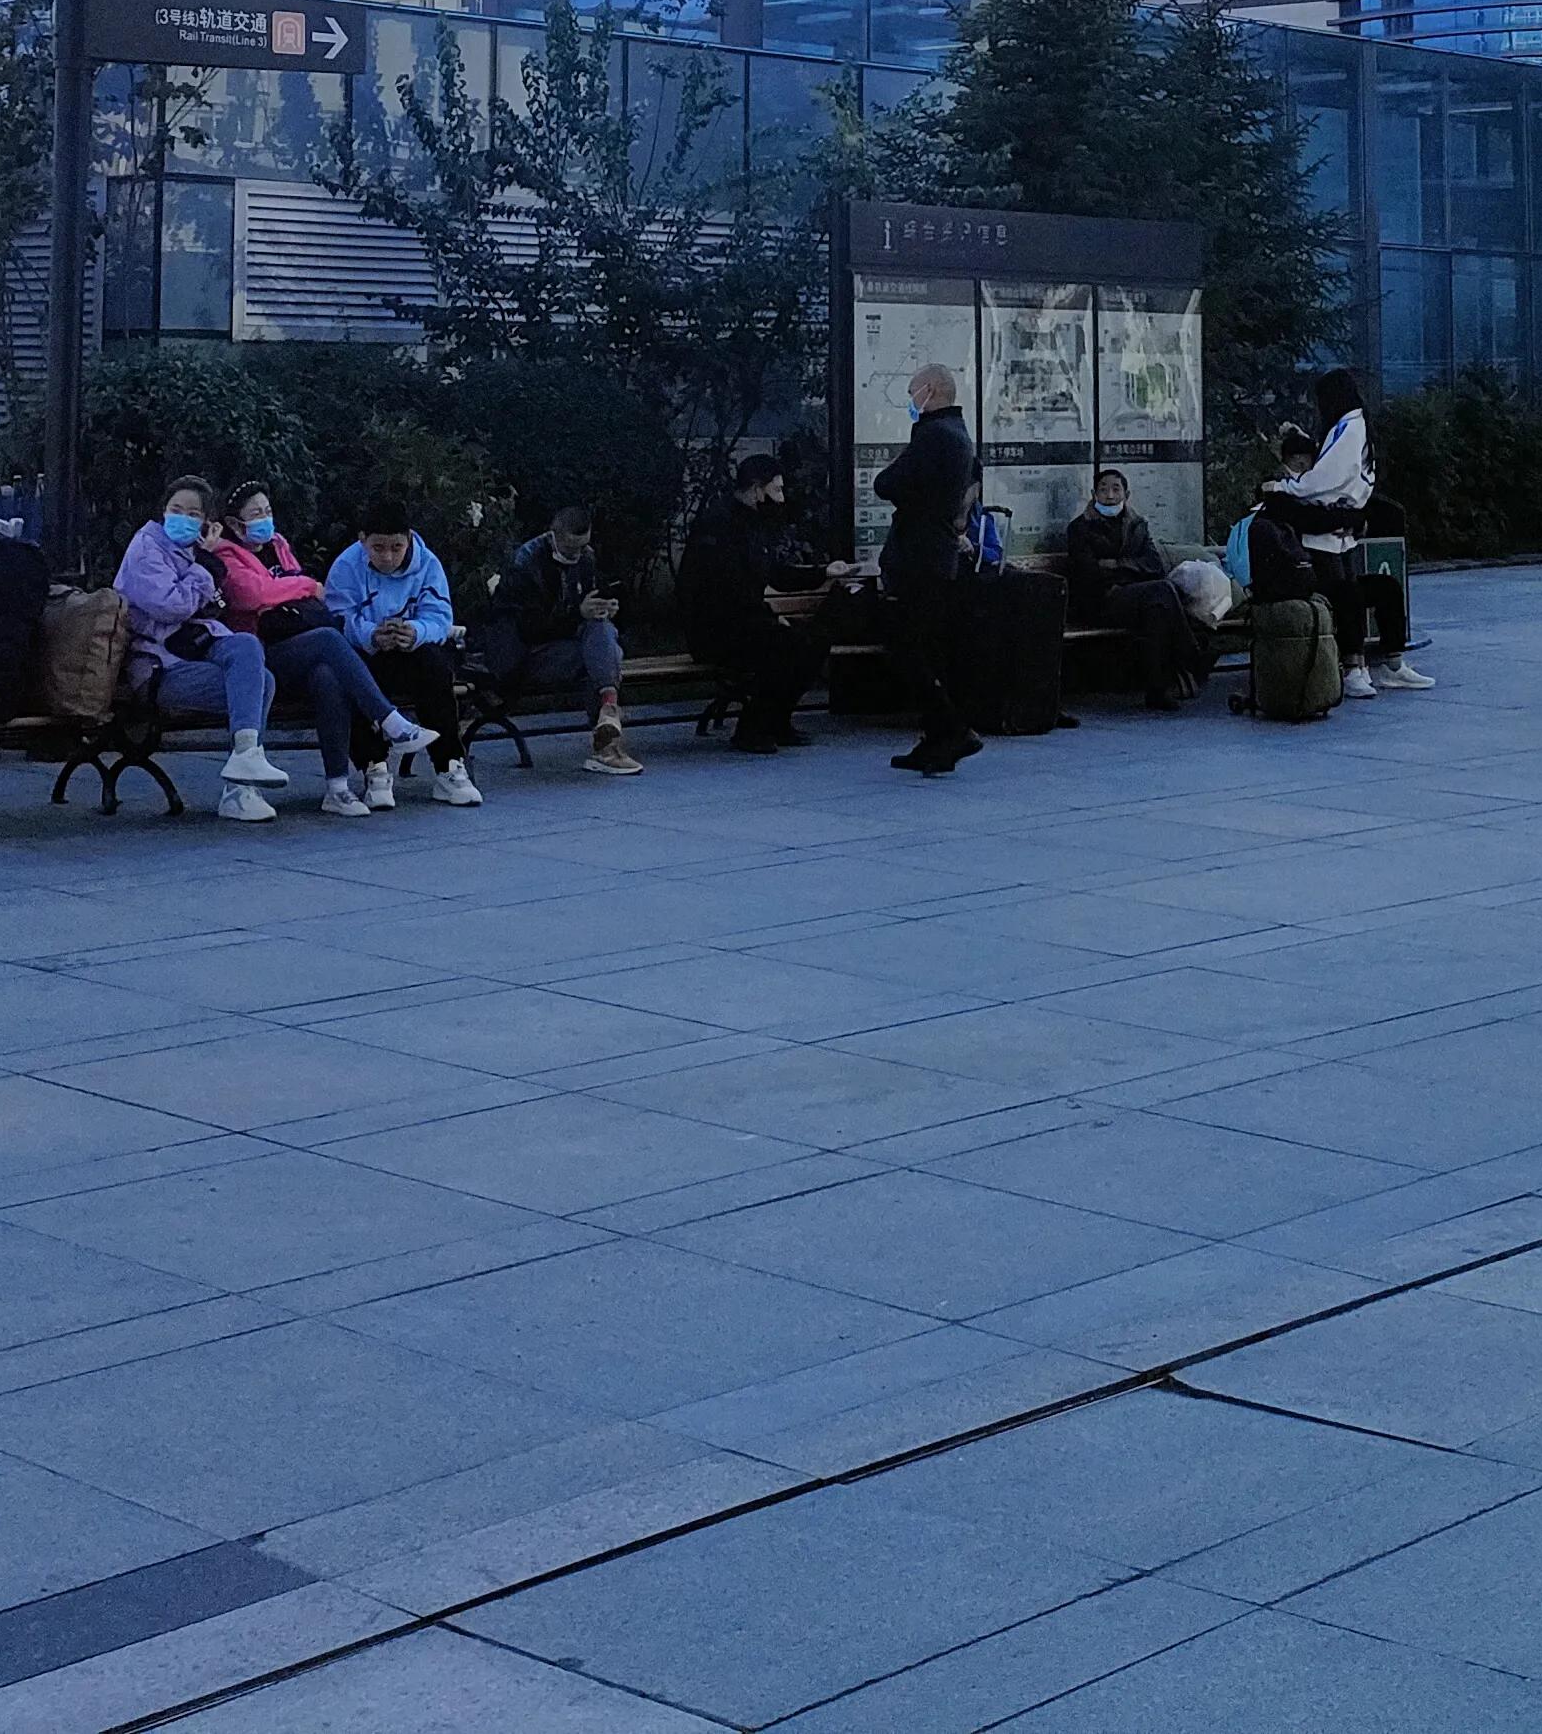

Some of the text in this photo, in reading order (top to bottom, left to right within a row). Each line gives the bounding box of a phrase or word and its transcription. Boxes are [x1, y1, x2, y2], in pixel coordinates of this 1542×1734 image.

[155, 7, 267, 34] (3号线)轨道交通
[179, 29, 198, 41] Rail
